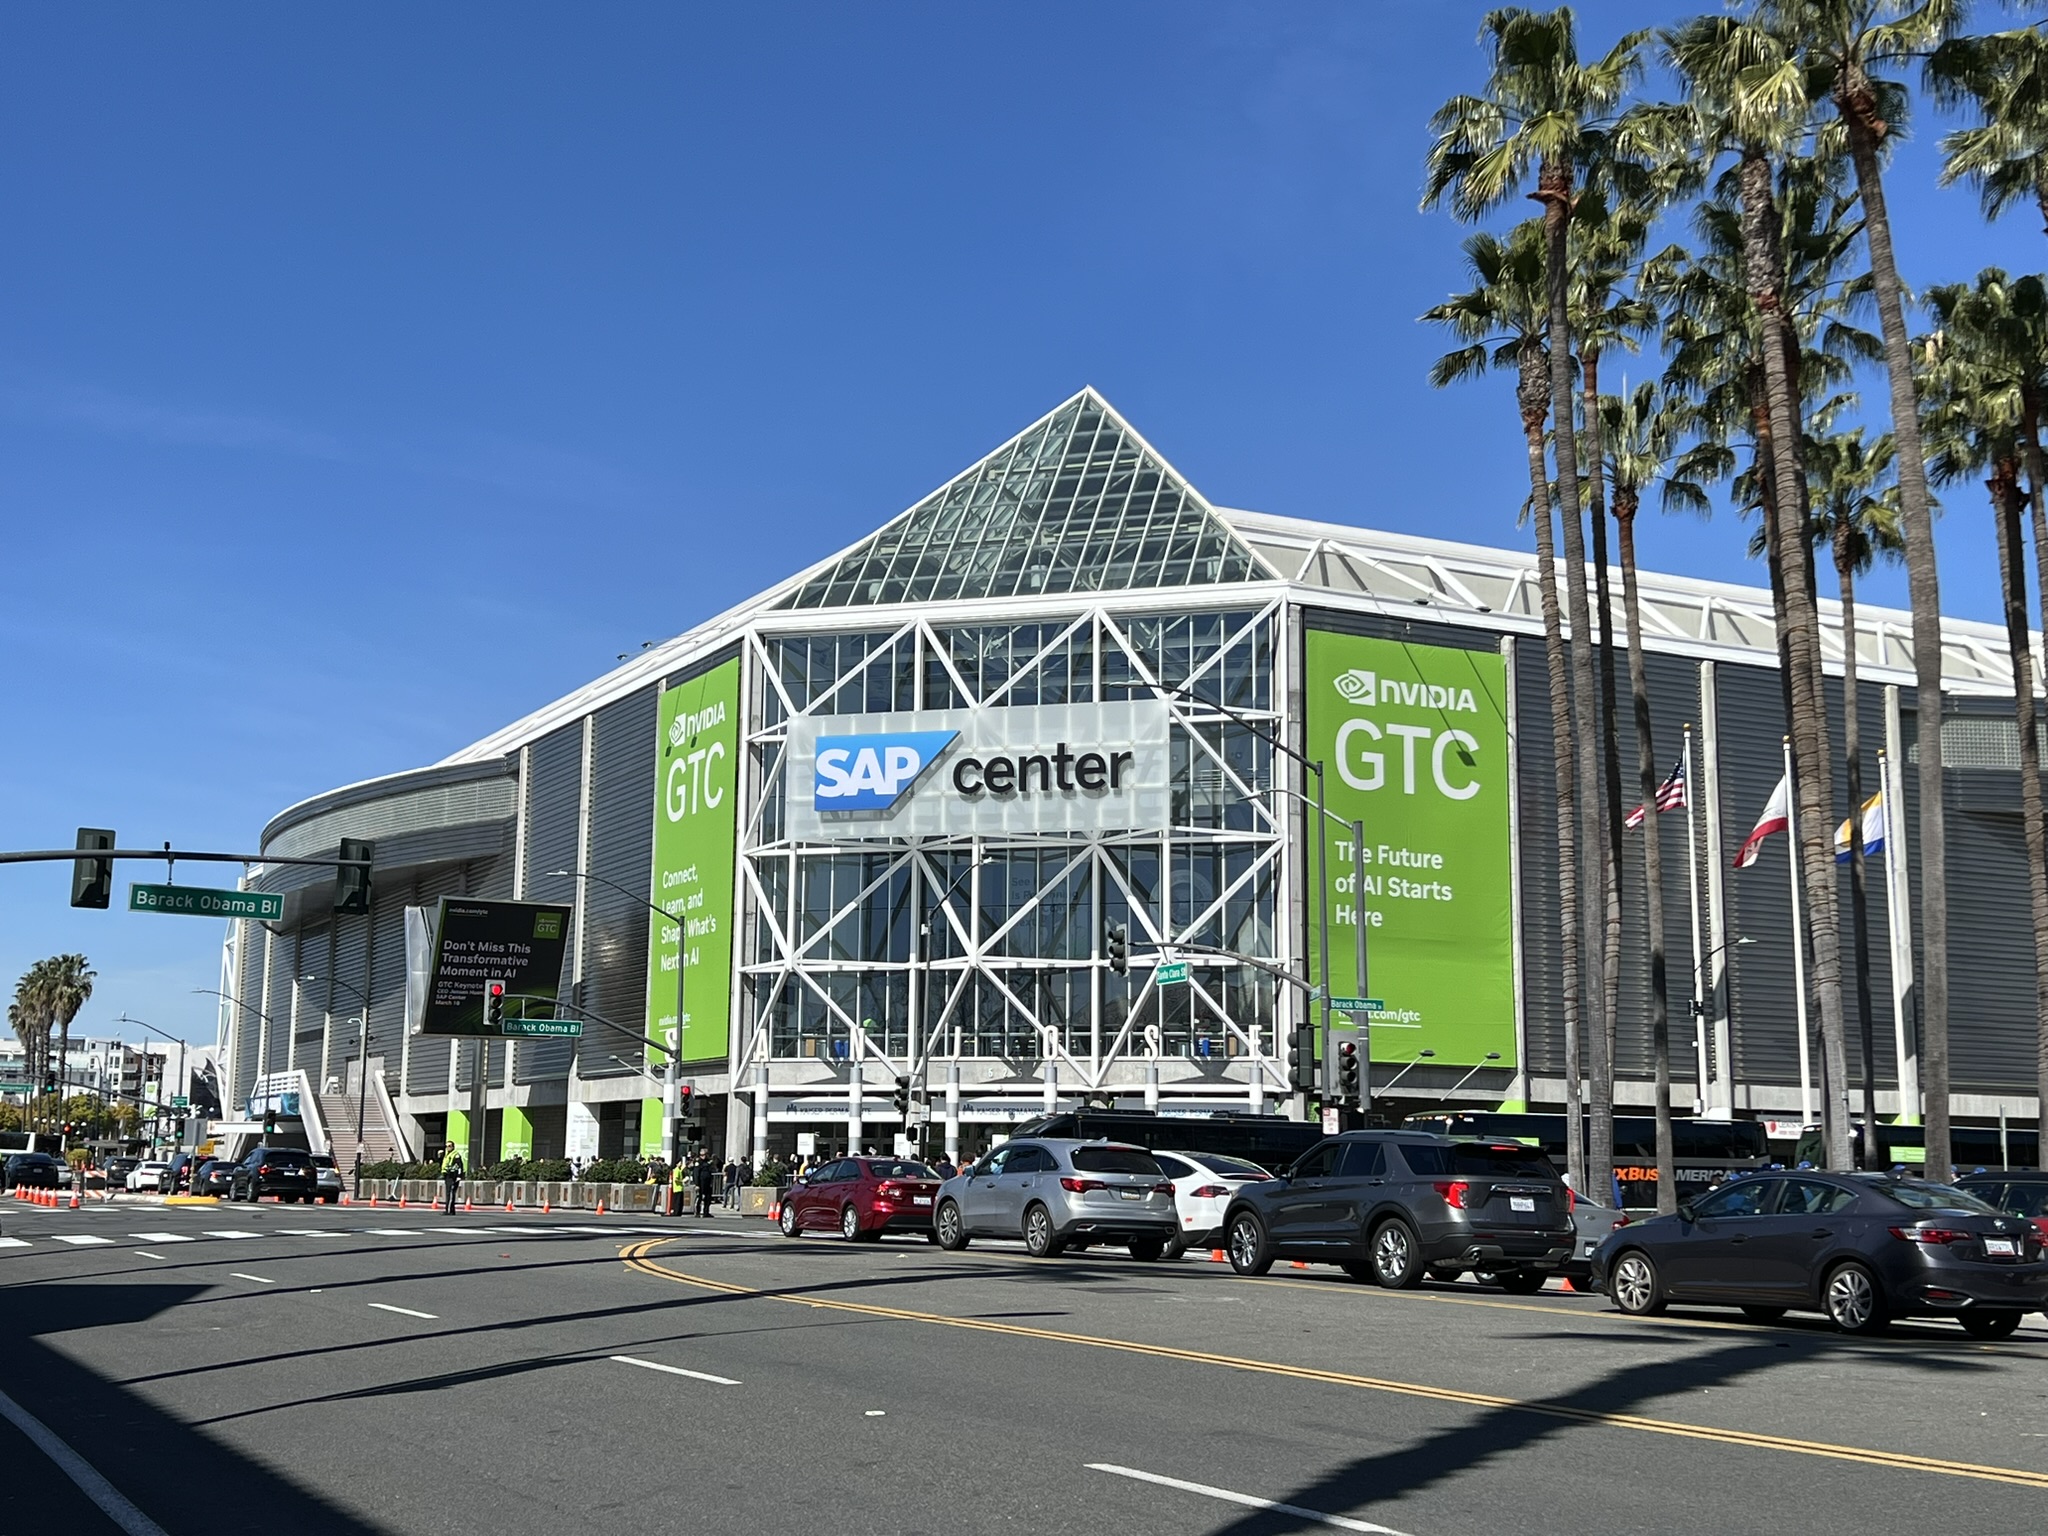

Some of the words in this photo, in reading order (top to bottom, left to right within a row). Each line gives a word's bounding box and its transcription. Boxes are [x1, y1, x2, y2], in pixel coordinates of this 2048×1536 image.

[815, 746, 920, 798] SAP
[953, 743, 1132, 794] center
[1335, 719, 1480, 800] GTC
[666, 741, 724, 823] GTC
[1378, 846, 1443, 870] Future
[663, 864, 698, 888] Connect,
[1335, 873, 1355, 893] of
[1364, 875, 1382, 895] AI
[1388, 877, 1452, 901] Starts
[136, 891, 193, 909] Barack
[200, 895, 255, 913] Obama
[262, 899, 277, 914] Bl
[688, 888, 703, 909] and
[538, 924, 556, 932] GTC
[661, 926, 685, 945] Shap
[688, 914, 716, 937] What's
[444, 940, 475, 950] Don't
[478, 942, 504, 952] Miss
[508, 943, 531, 954] This
[691, 947, 699, 966] AI
[442, 953, 528, 966] Transformative
[440, 966, 488, 977] Moment
[491, 967, 502, 977] in
[504, 968, 516, 978] AI
[1331, 1000, 1353, 1009] Barack
[1355, 1000, 1377, 1010] Obama
[506, 1022, 536, 1032] Barack
[539, 1022, 568, 1033] Obama
